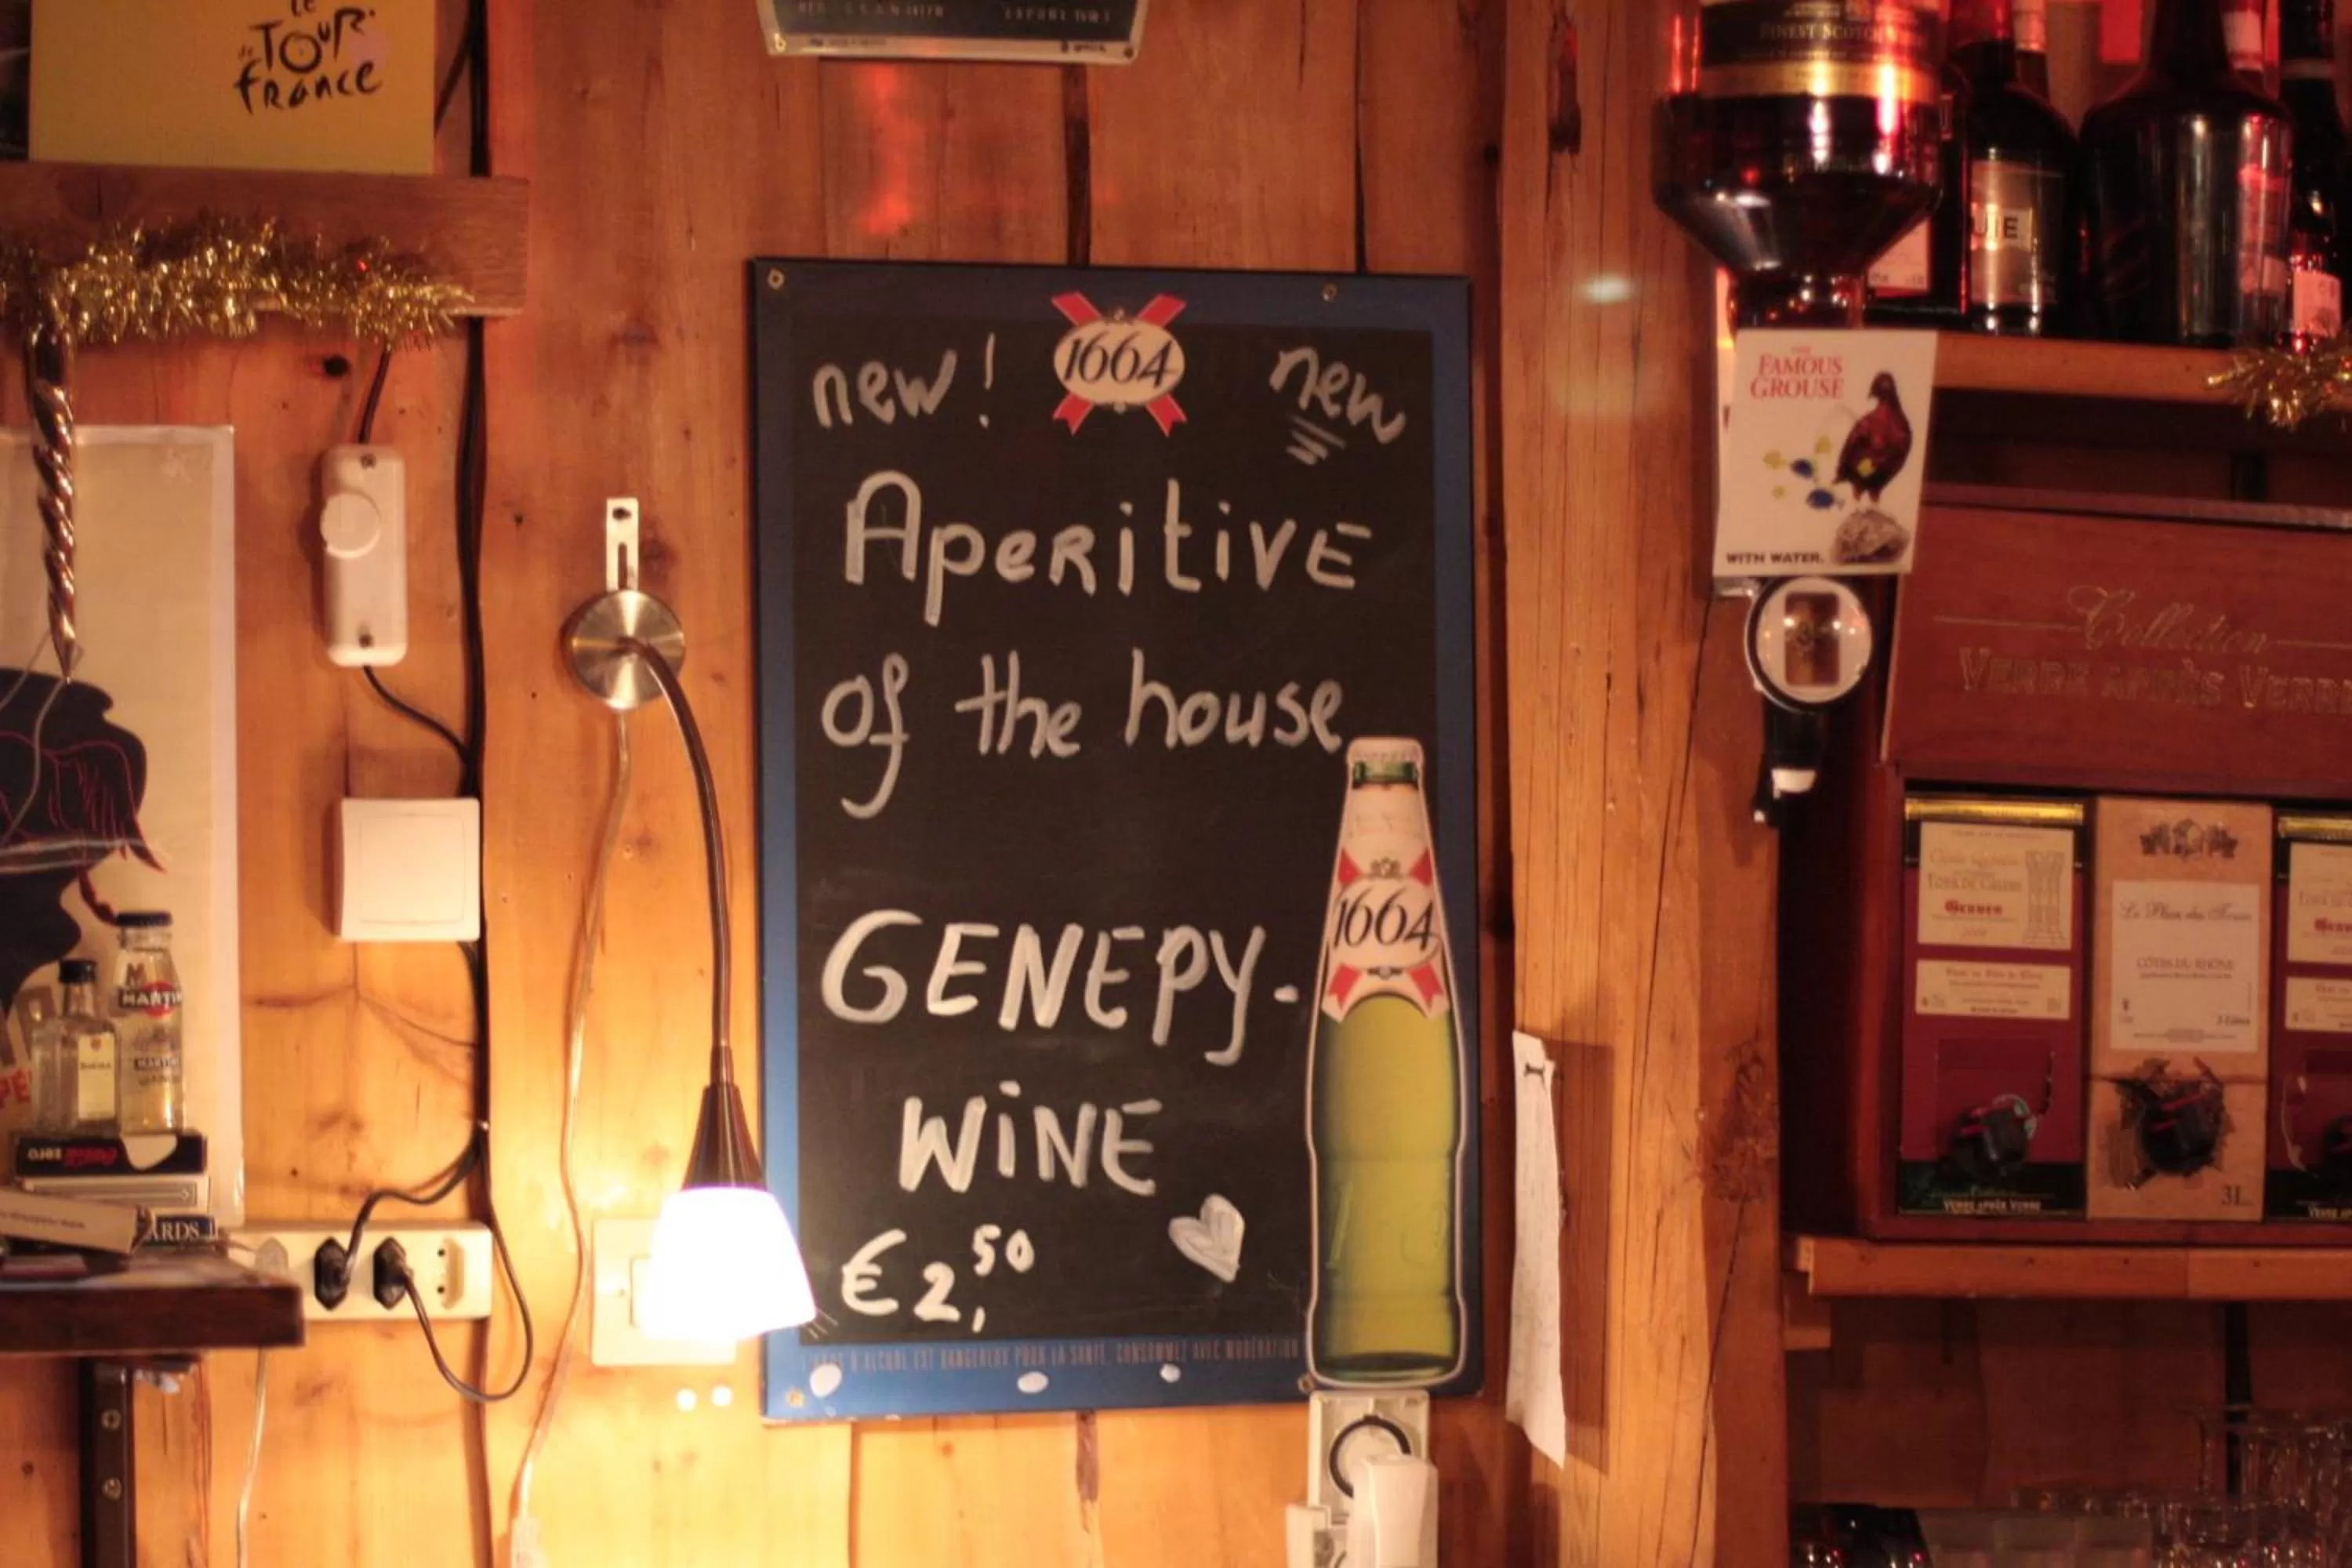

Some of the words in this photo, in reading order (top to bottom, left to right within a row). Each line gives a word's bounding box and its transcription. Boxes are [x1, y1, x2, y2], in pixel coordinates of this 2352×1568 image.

[1063, 329, 1180, 389] 1664
[1750, 378, 1844, 400] GROUSE
[1759, 354, 1843, 376] FAMOUS
[1269, 347, 1406, 445] new
[1726, 552, 1766, 564] WITH
[820, 652, 909, 819] of
[954, 650, 1082, 760] the
[1124, 648, 1342, 752] house
[1334, 887, 1438, 952] 1664
